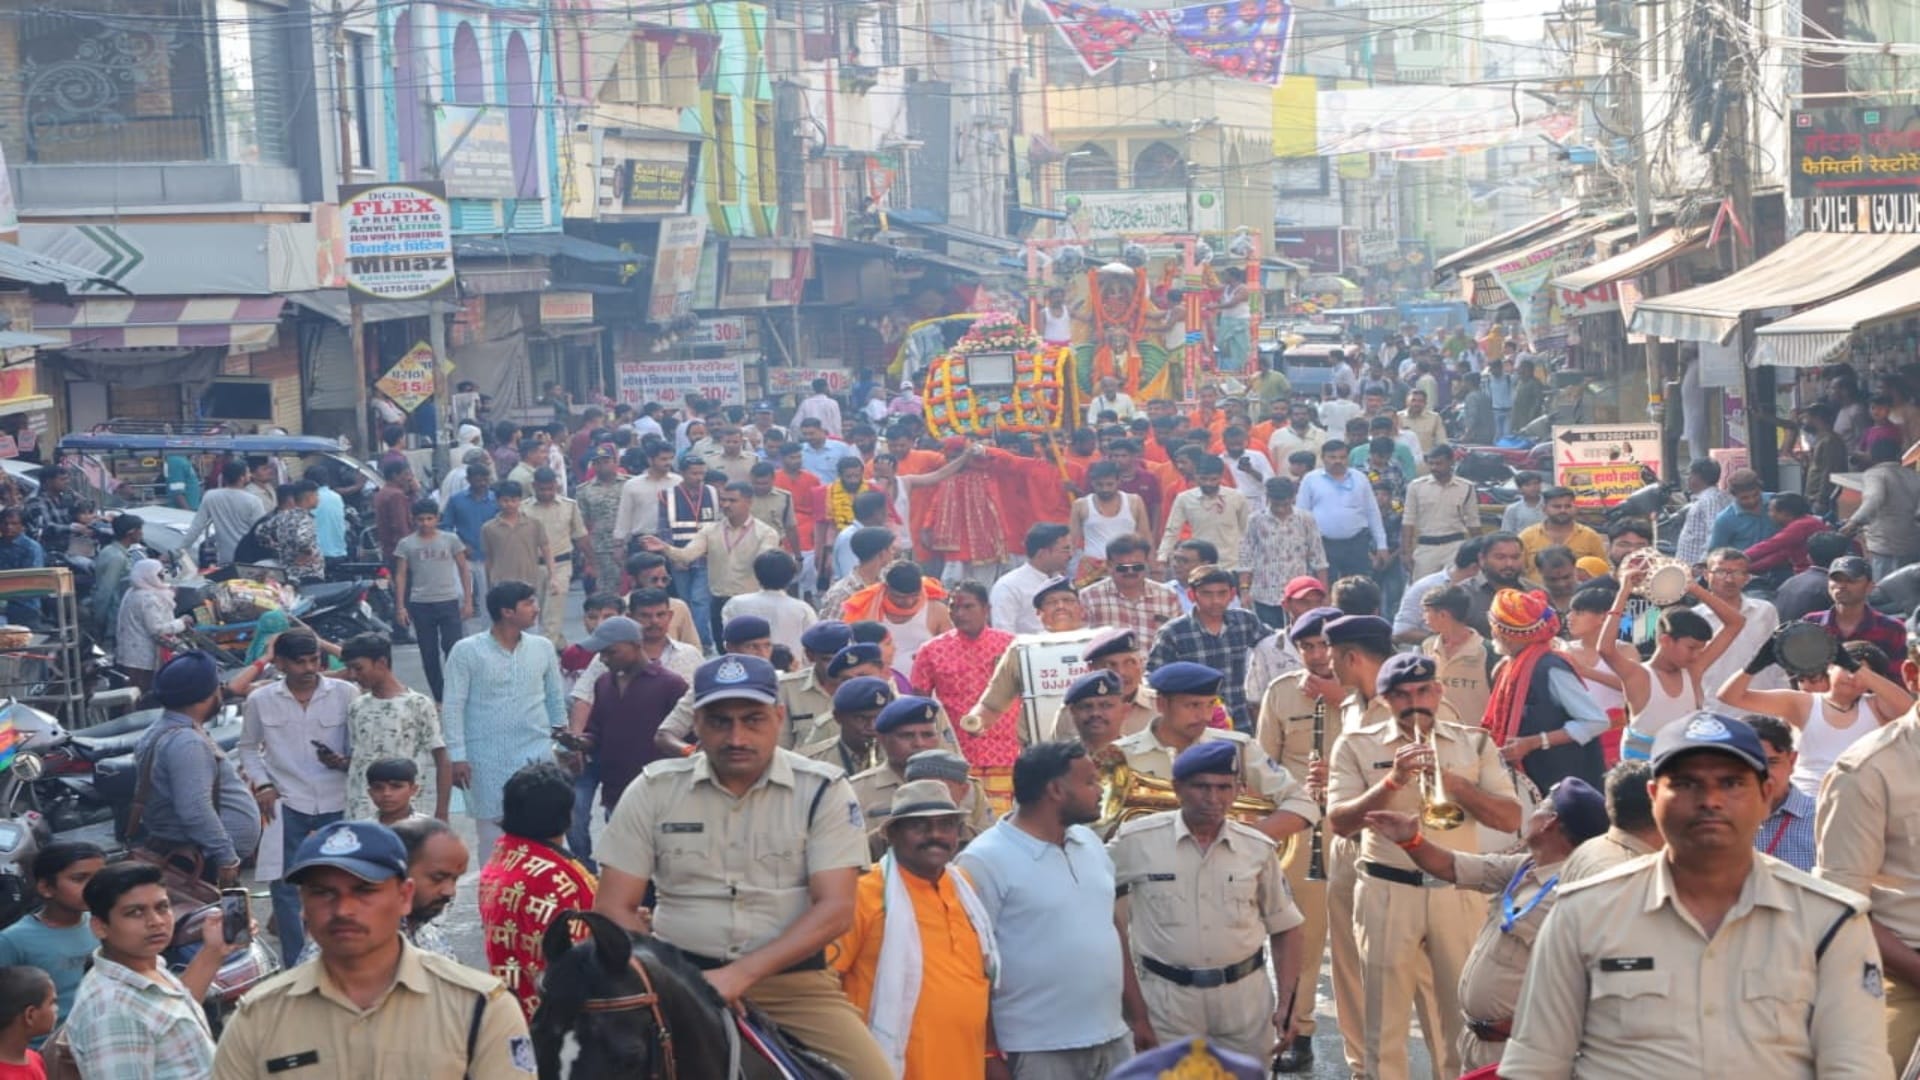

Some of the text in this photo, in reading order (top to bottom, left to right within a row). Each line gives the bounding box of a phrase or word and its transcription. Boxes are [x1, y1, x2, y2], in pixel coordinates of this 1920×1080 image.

[1801, 154, 1863, 174] फैमिली
[351, 198, 437, 217] FLEX
[1809, 194, 1857, 233] HOTEL
[361, 213, 442, 224] PRINTING
[351, 255, 448, 275] Minaz
[1040, 668, 1059, 678] 32
[1041, 679, 1075, 690] UJJA
